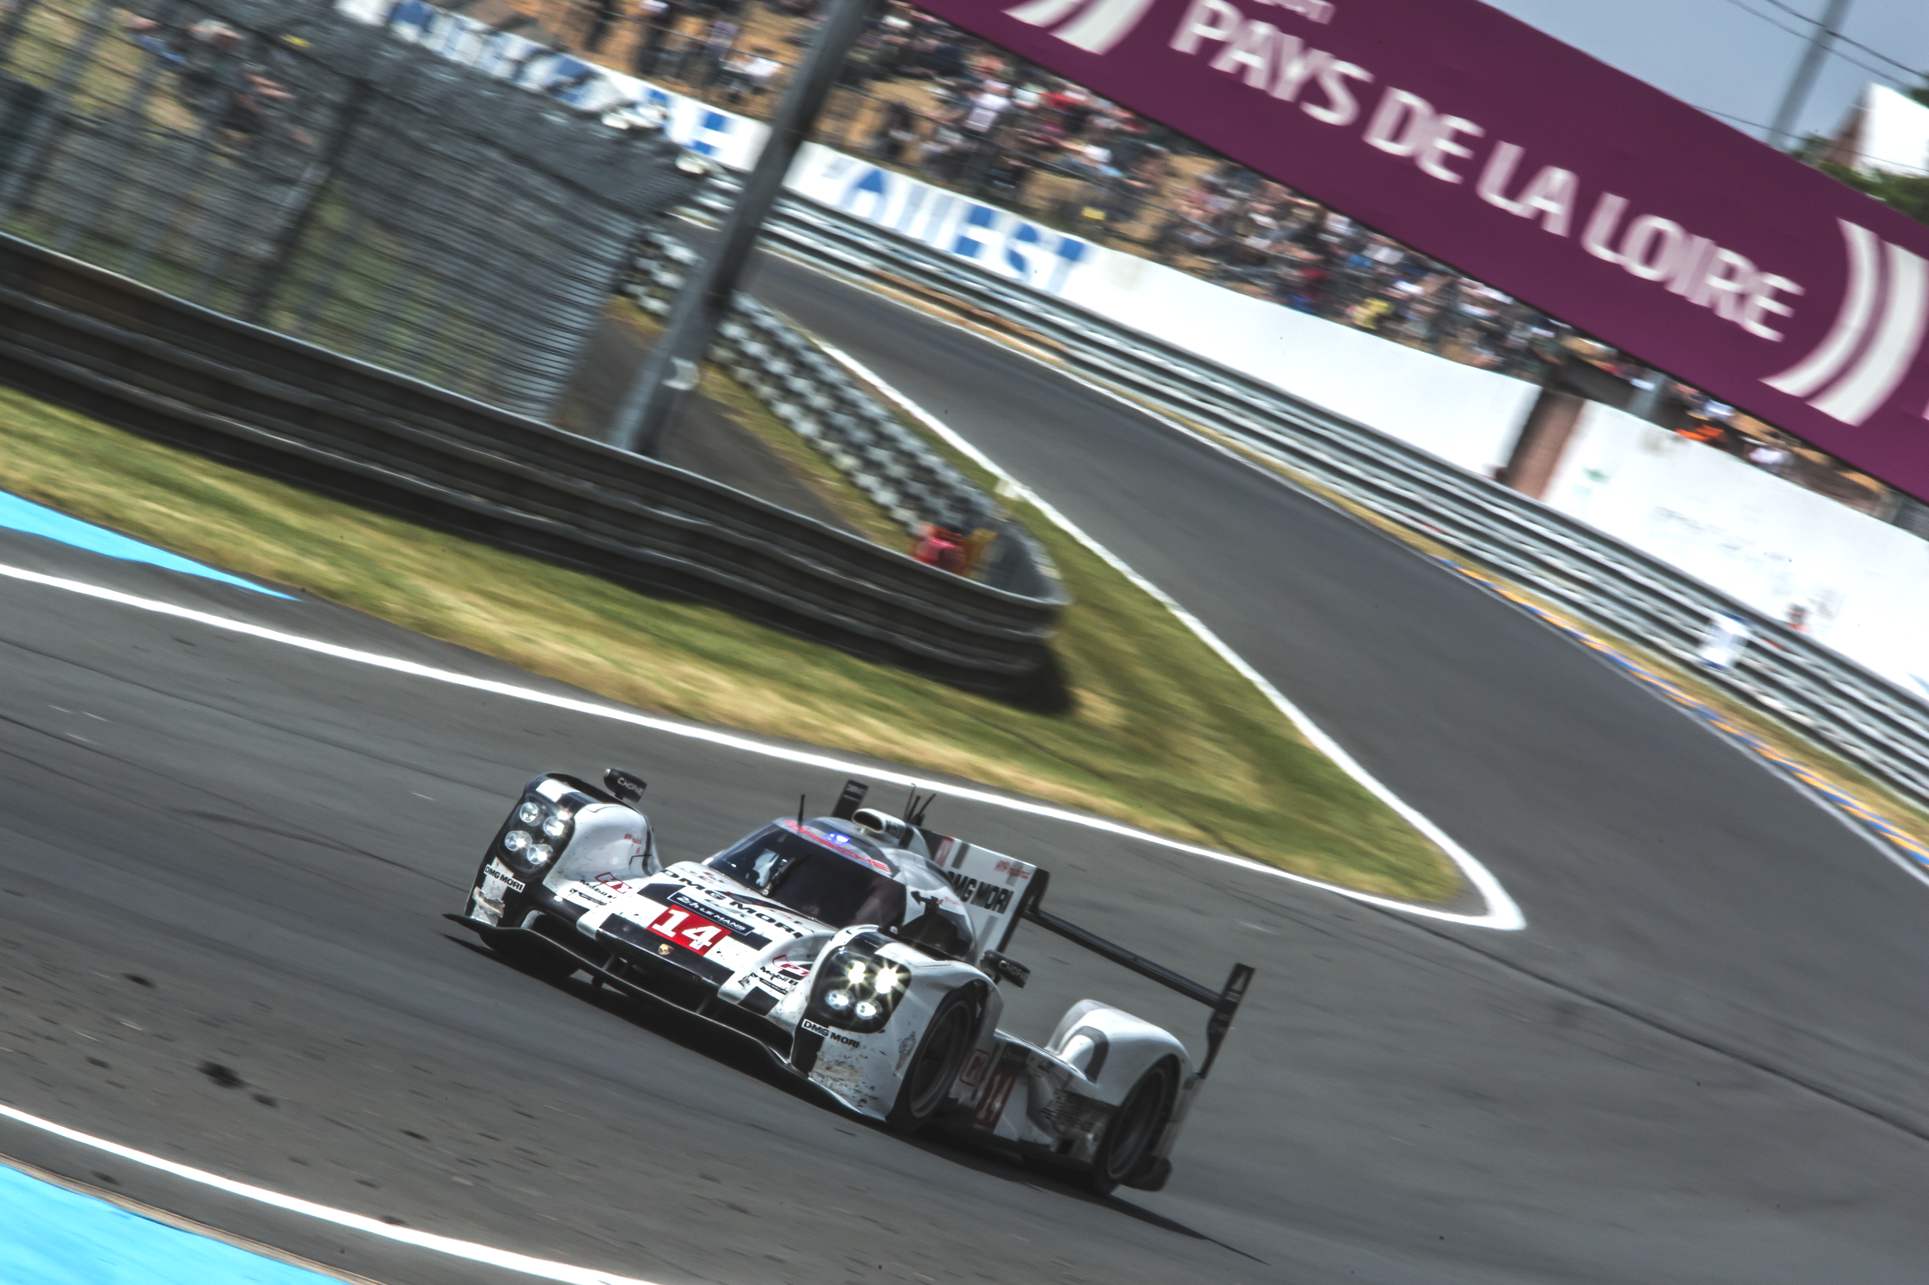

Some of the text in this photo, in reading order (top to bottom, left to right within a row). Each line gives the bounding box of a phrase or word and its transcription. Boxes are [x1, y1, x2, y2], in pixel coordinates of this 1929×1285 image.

[1169, 0, 1805, 342] PAYS DE LA LOIRE
[500, 875, 524, 892] MORI
[663, 869, 727, 901] DMG
[729, 900, 804, 939] MORI
[947, 870, 977, 903] MG
[970, 880, 1014, 915] MORI
[651, 908, 723, 951] 14
[713, 914, 747, 931] MANS
[803, 1019, 861, 1049] DMG MORI
